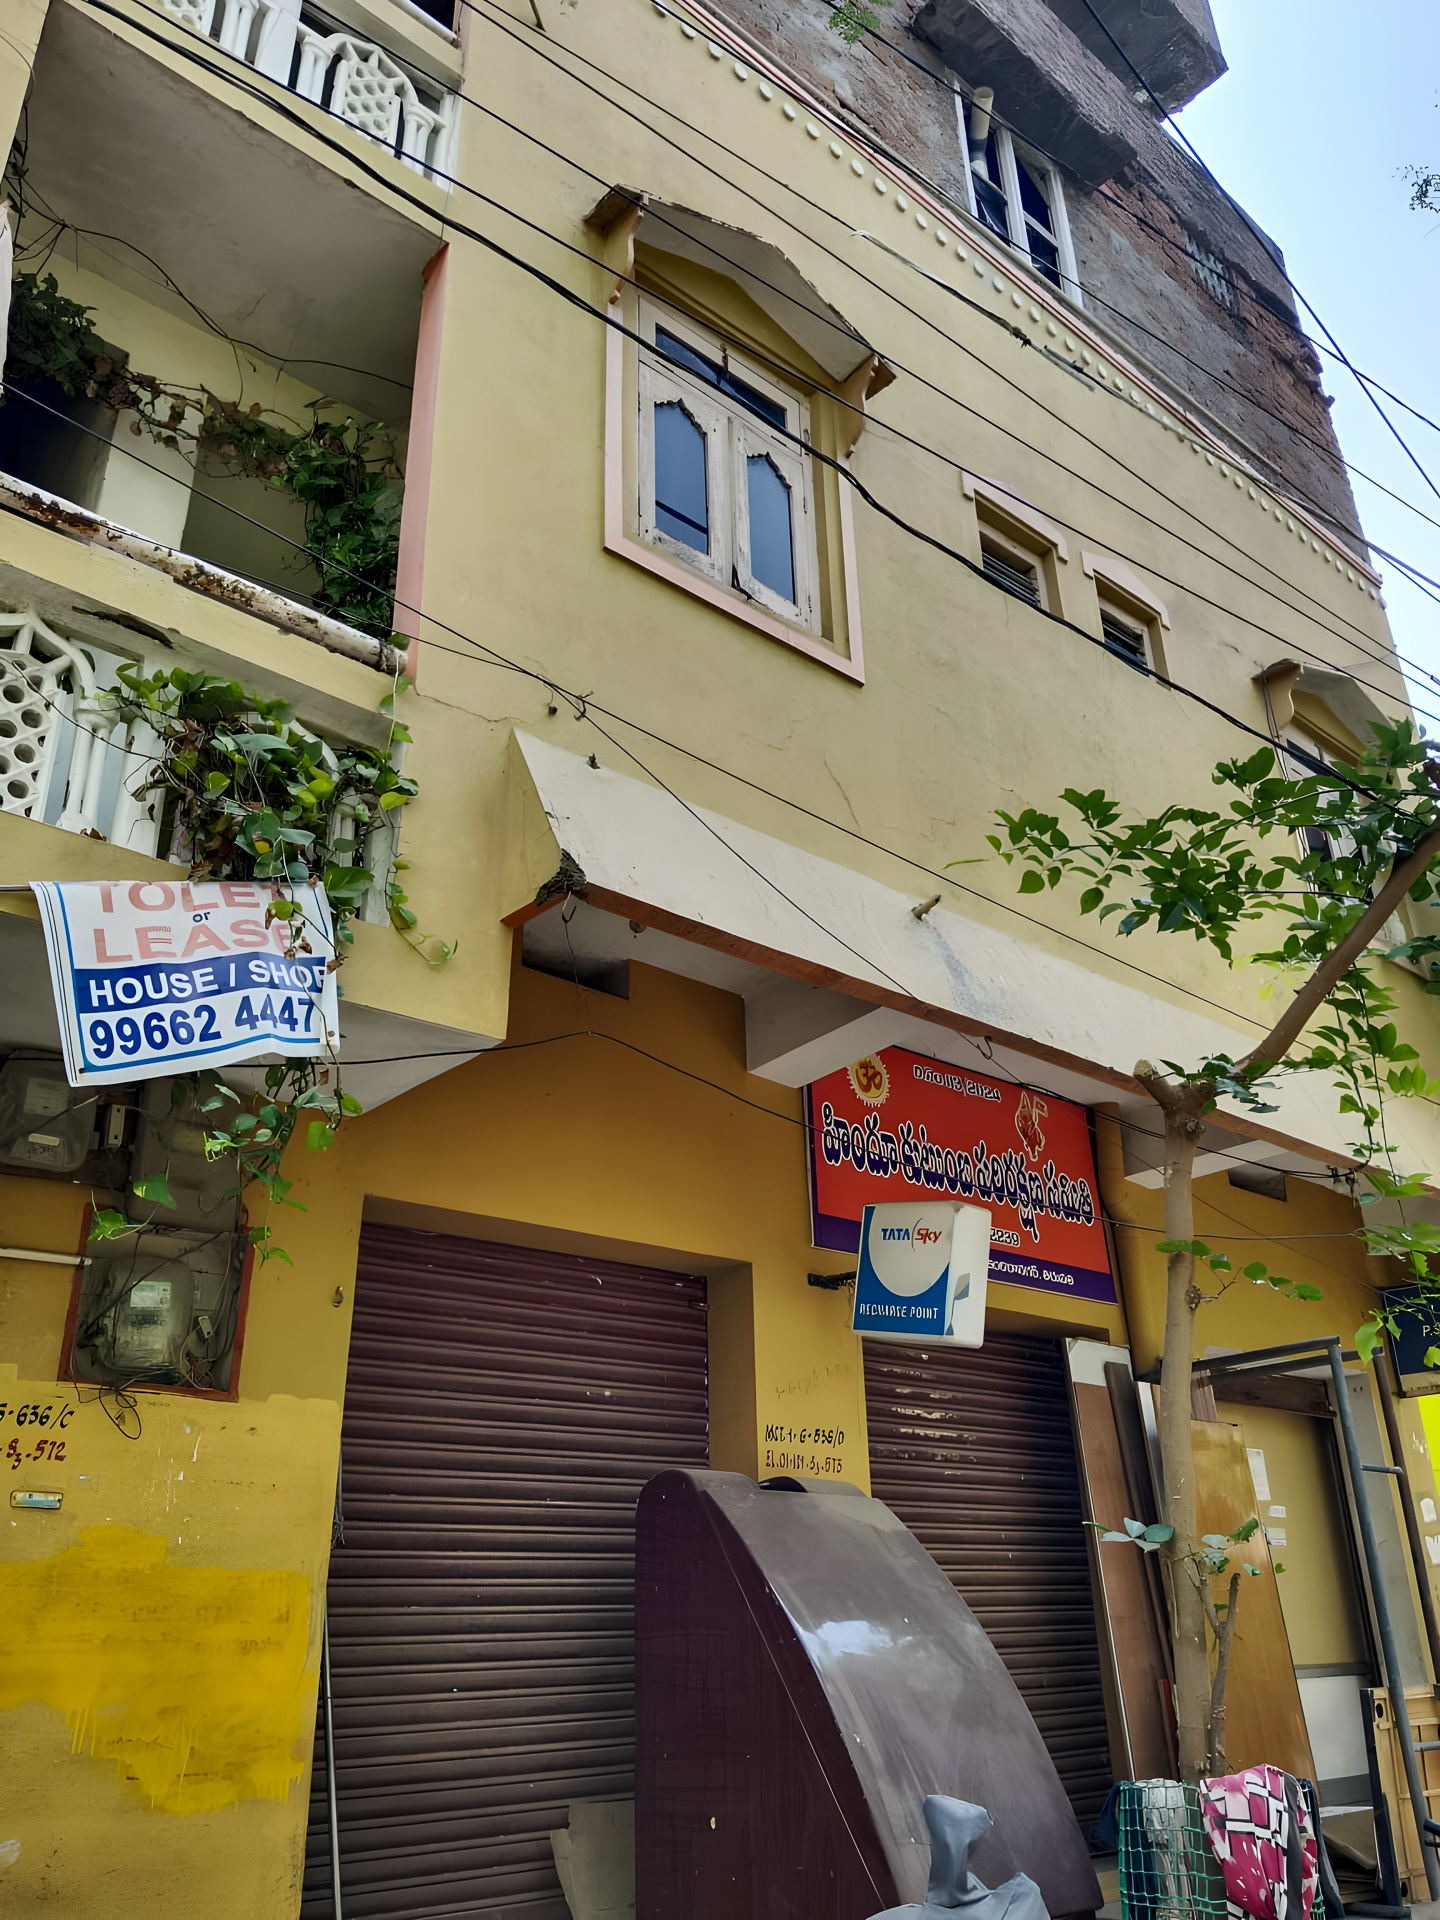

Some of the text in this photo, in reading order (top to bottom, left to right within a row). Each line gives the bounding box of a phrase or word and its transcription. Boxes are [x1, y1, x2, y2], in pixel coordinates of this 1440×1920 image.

[193, 912, 211, 923] or
[89, 967, 219, 1007] HOUSE
[90, 994, 314, 1059] 99662 4447
[882, 1228, 910, 1240] TATA
[910, 1306, 938, 1319] POINT
